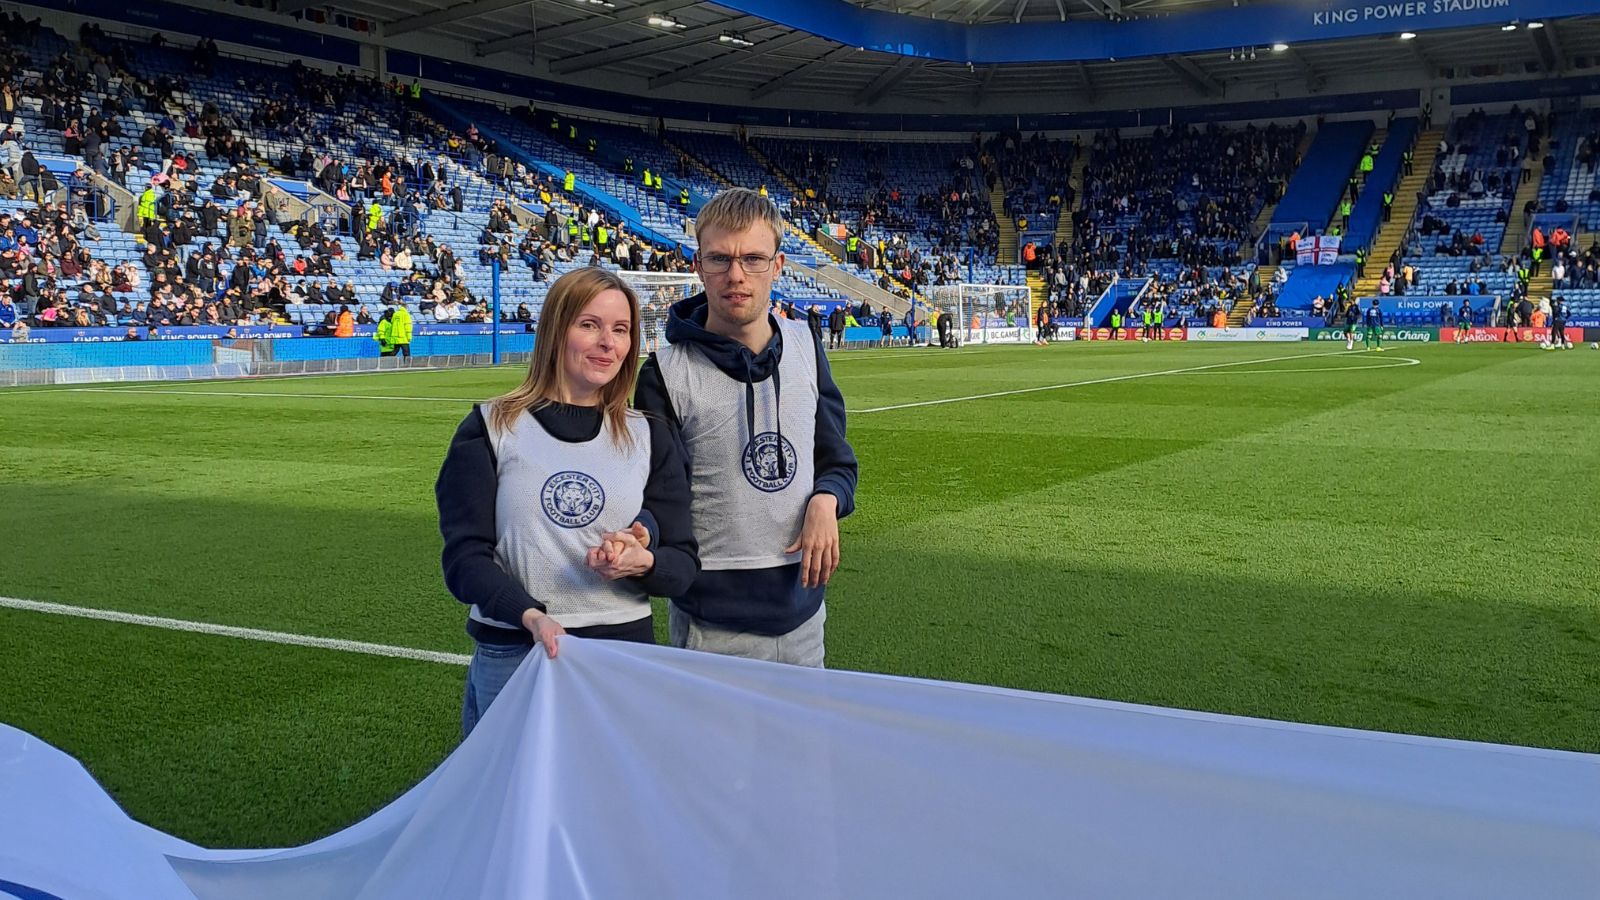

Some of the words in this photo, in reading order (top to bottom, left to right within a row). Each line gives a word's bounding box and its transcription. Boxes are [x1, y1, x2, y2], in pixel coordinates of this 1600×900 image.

[1313, 8, 1358, 25] KING
[1364, 2, 1427, 20] POWER
[1397, 330, 1431, 342] Chang
[546, 474, 589, 494] LEICESTER
[588, 481, 601, 500] CITY
[746, 467, 783, 488] FOOTBALL
[544, 497, 581, 525] FOOTBALL
[580, 503, 600, 523] CLUB
